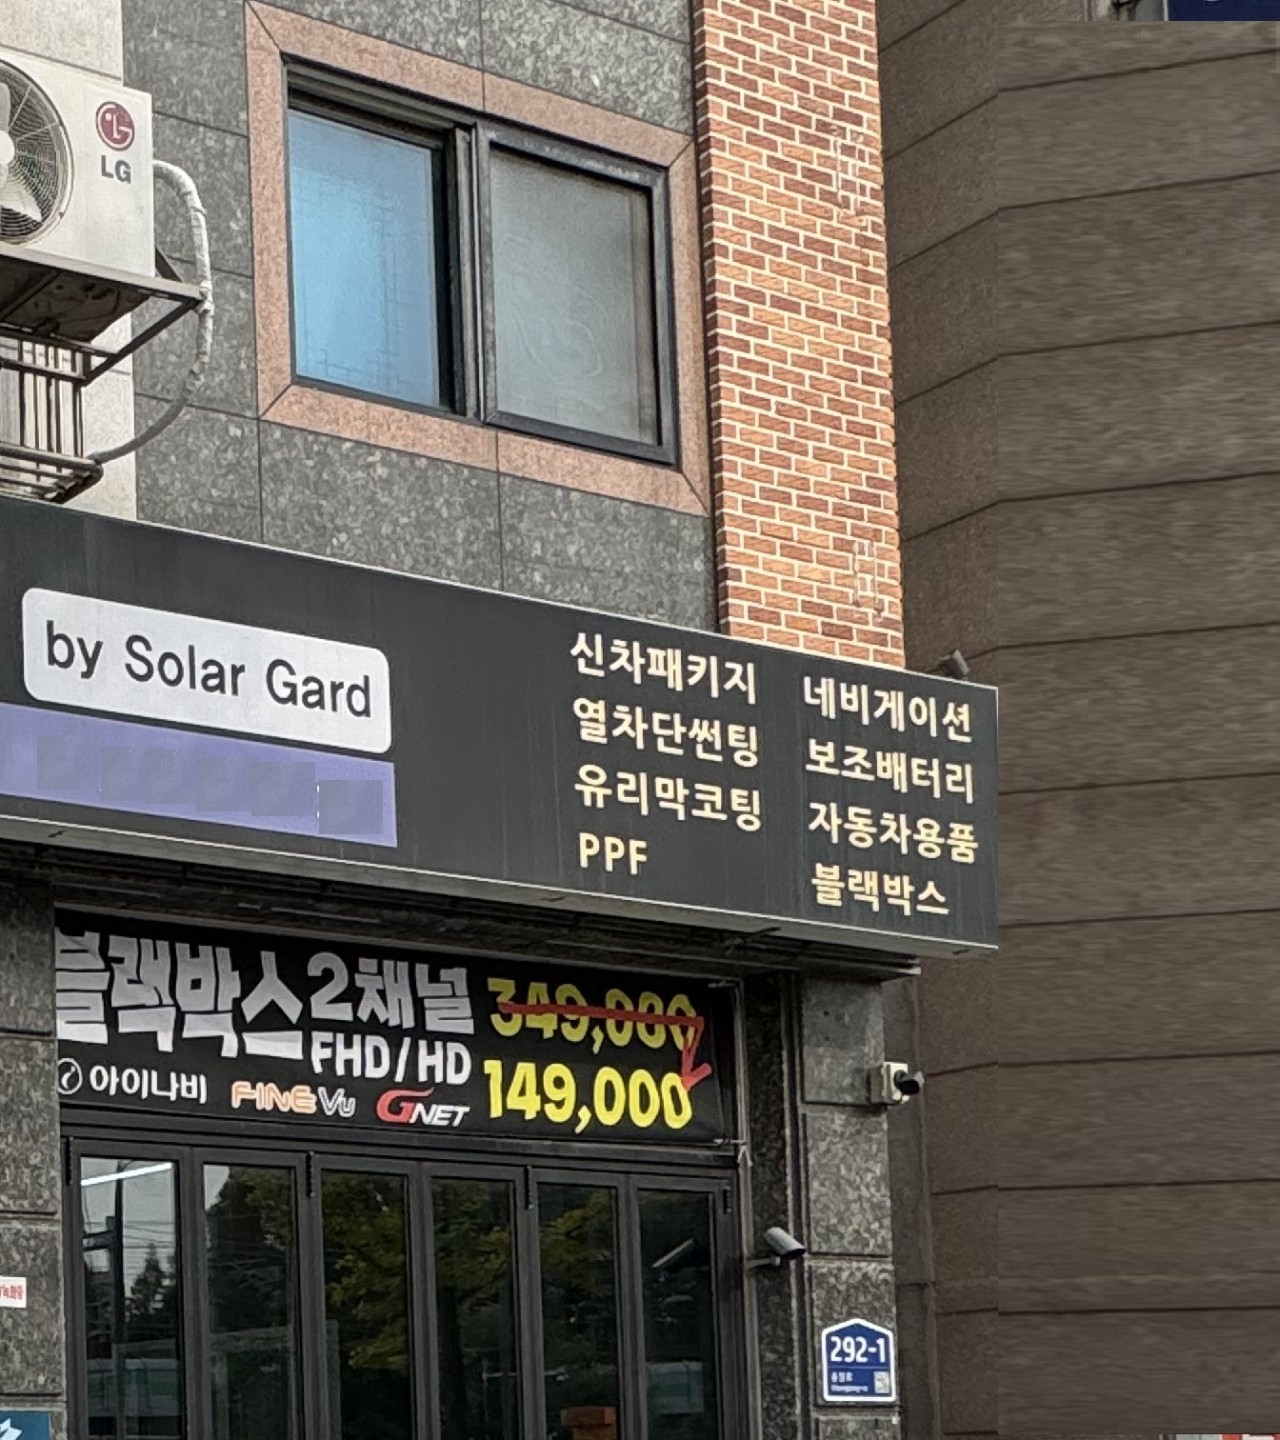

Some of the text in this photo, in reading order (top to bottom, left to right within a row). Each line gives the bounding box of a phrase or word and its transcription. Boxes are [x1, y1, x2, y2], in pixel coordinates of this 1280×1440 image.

[100, 154, 132, 184] LG
[45, 619, 372, 718] by Solar Gard
[569, 630, 757, 705] 신차패키지
[572, 696, 760, 768] 열차단썬팅
[802, 674, 974, 744] 네비게이션
[573, 763, 763, 832] 유리막코팅
[805, 737, 975, 803] 보조배터리
[577, 831, 648, 876] PPF
[808, 801, 980, 865] 자동차용품
[810, 862, 951, 917] 블랙박스
[88, 1064, 209, 1104] 아이나비
[375, 1086, 471, 1128] GNET
[483, 1058, 693, 1135] 149,000
[830, 1336, 886, 1363] 292-1
